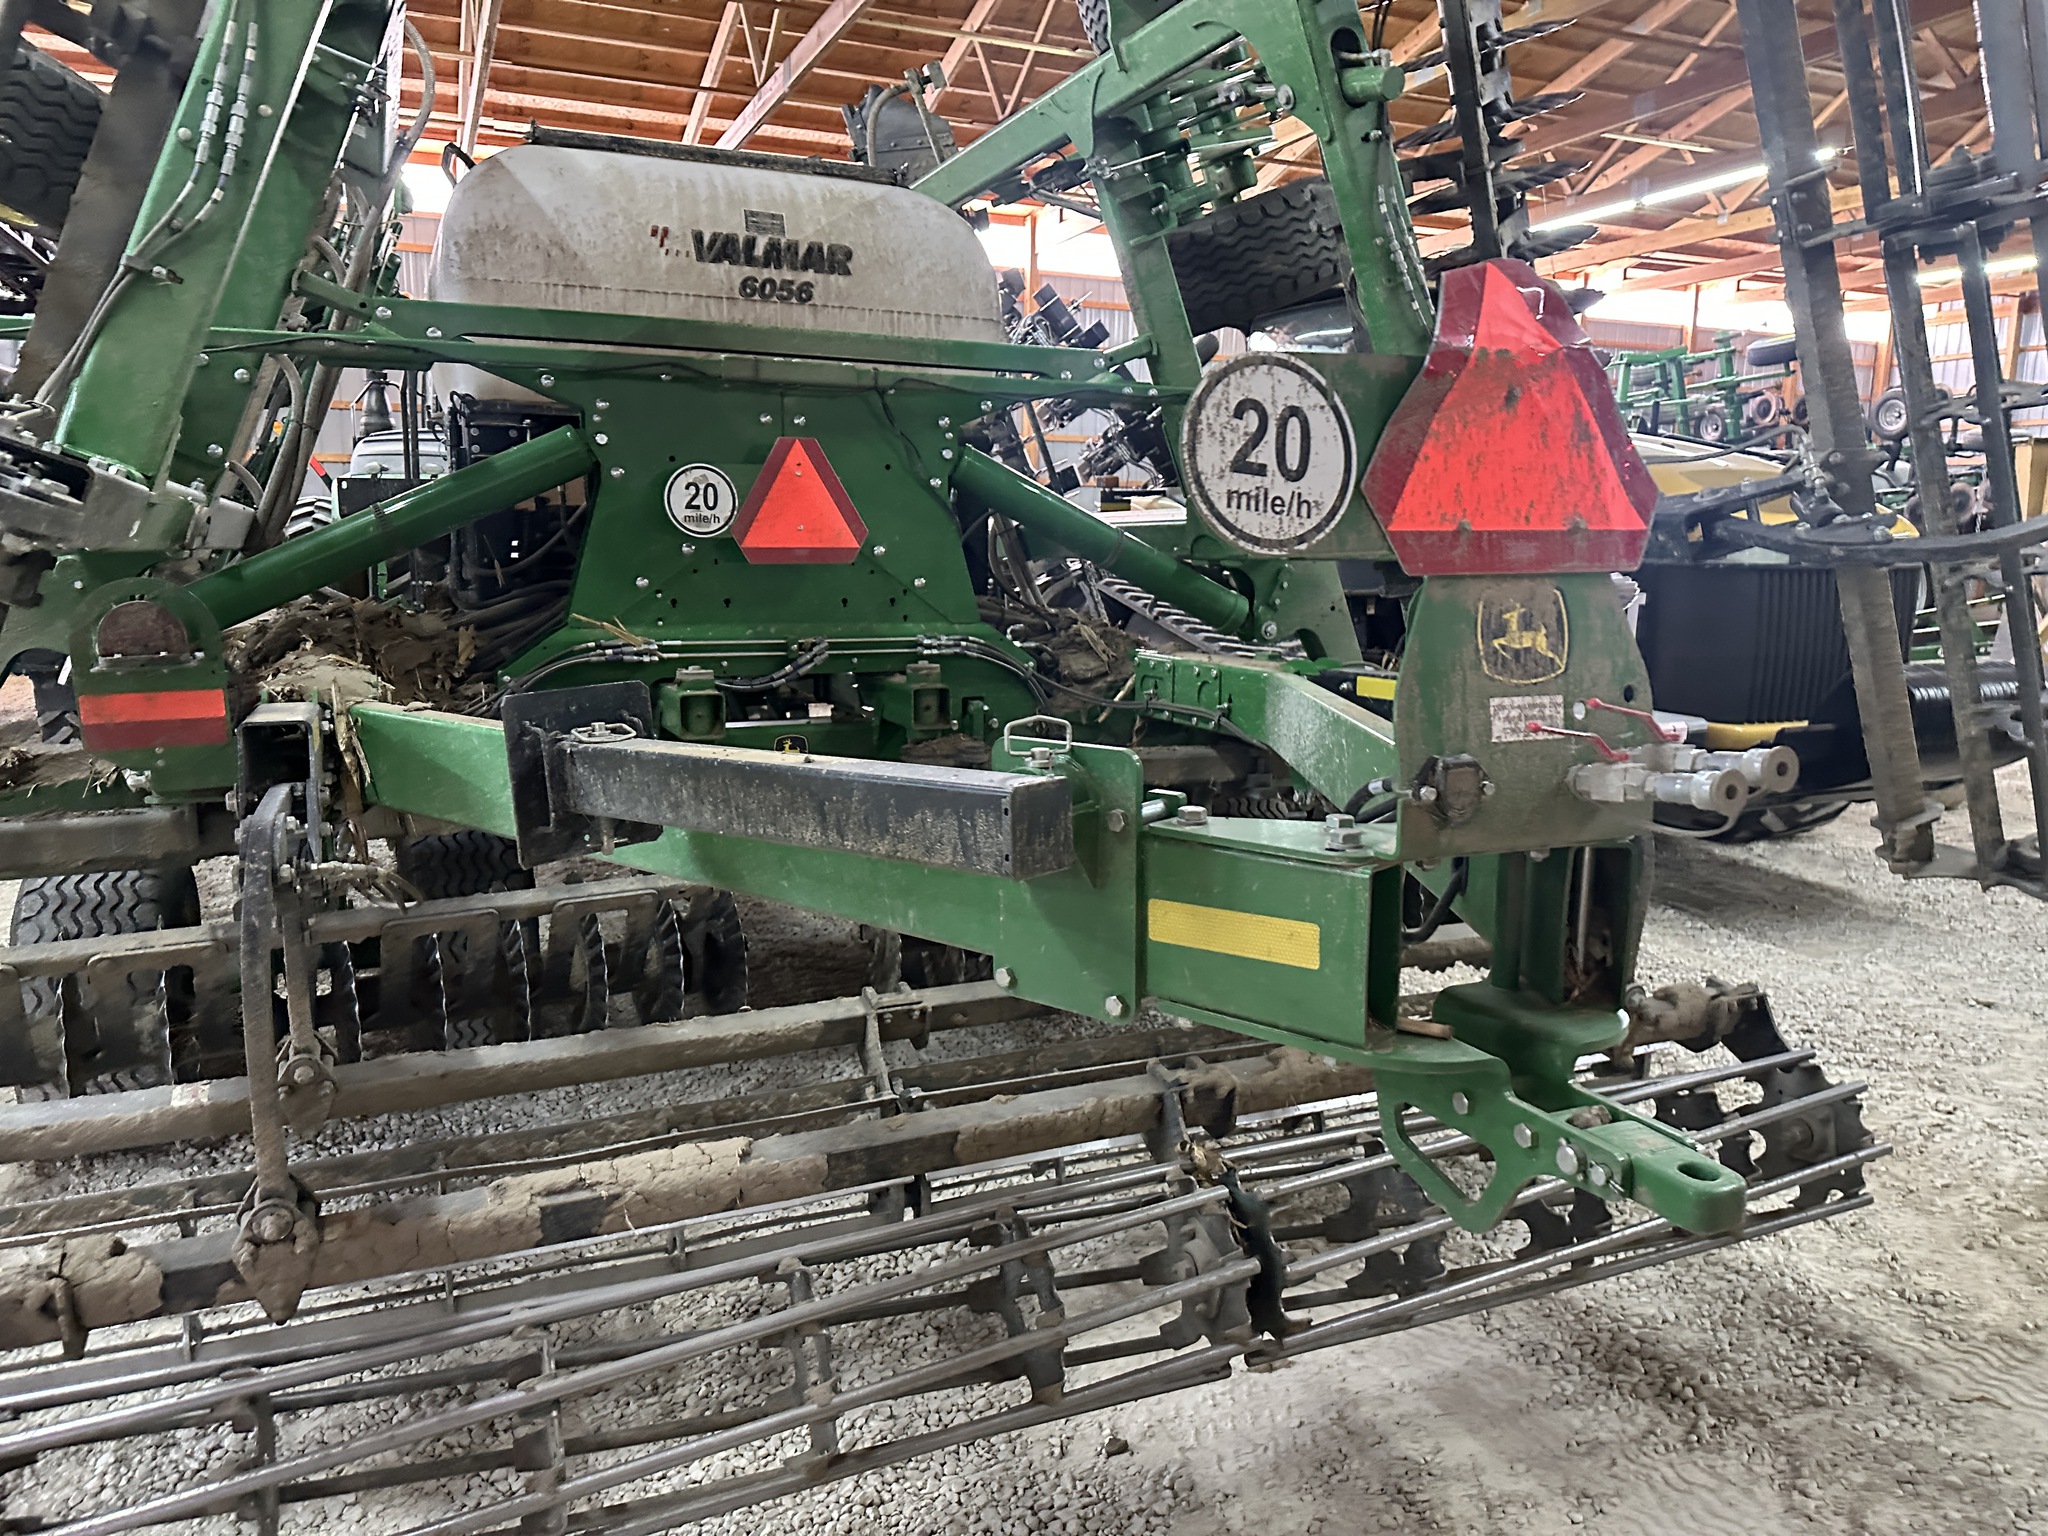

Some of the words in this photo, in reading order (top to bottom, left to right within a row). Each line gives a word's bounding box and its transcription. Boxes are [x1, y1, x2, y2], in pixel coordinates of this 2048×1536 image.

[691, 229, 854, 276] VALMAR
[739, 276, 815, 304] 6056
[1231, 397, 1312, 483] 20
[684, 481, 719, 511] 20
[1226, 486, 1313, 519] mile/h
[684, 513, 721, 524] mile/h
